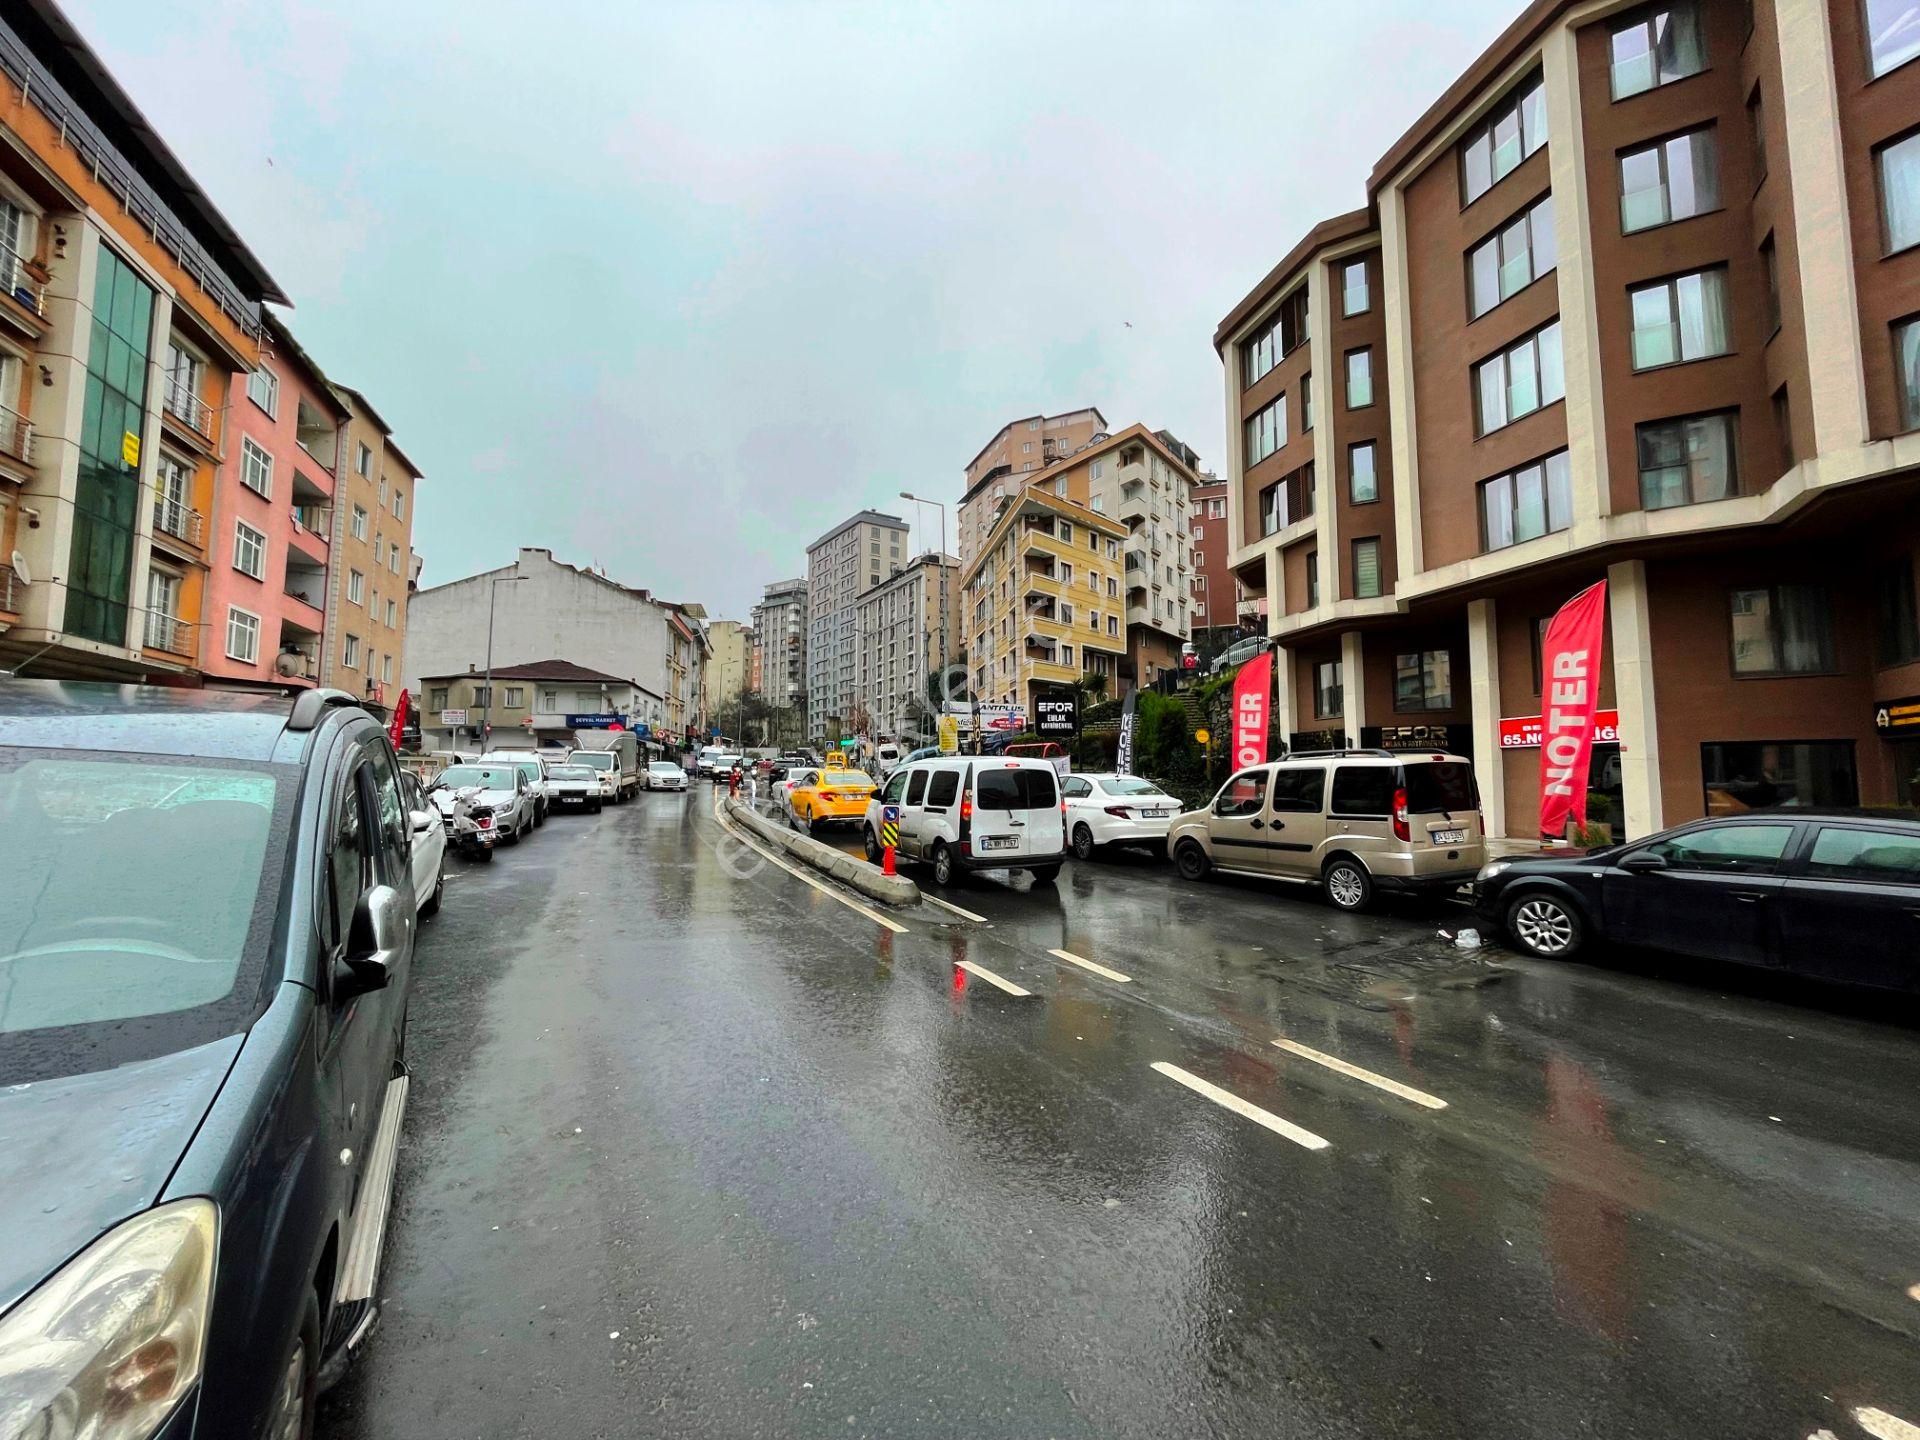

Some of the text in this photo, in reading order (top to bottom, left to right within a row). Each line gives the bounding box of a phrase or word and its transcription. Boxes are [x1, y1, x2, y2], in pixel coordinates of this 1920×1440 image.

[1038, 702, 1073, 712] EFOR
[1047, 714, 1066, 722] EMLAK
[1544, 649, 1588, 796] NOTER
[1238, 693, 1262, 770] OTER
[1381, 726, 1448, 740] EFOR
